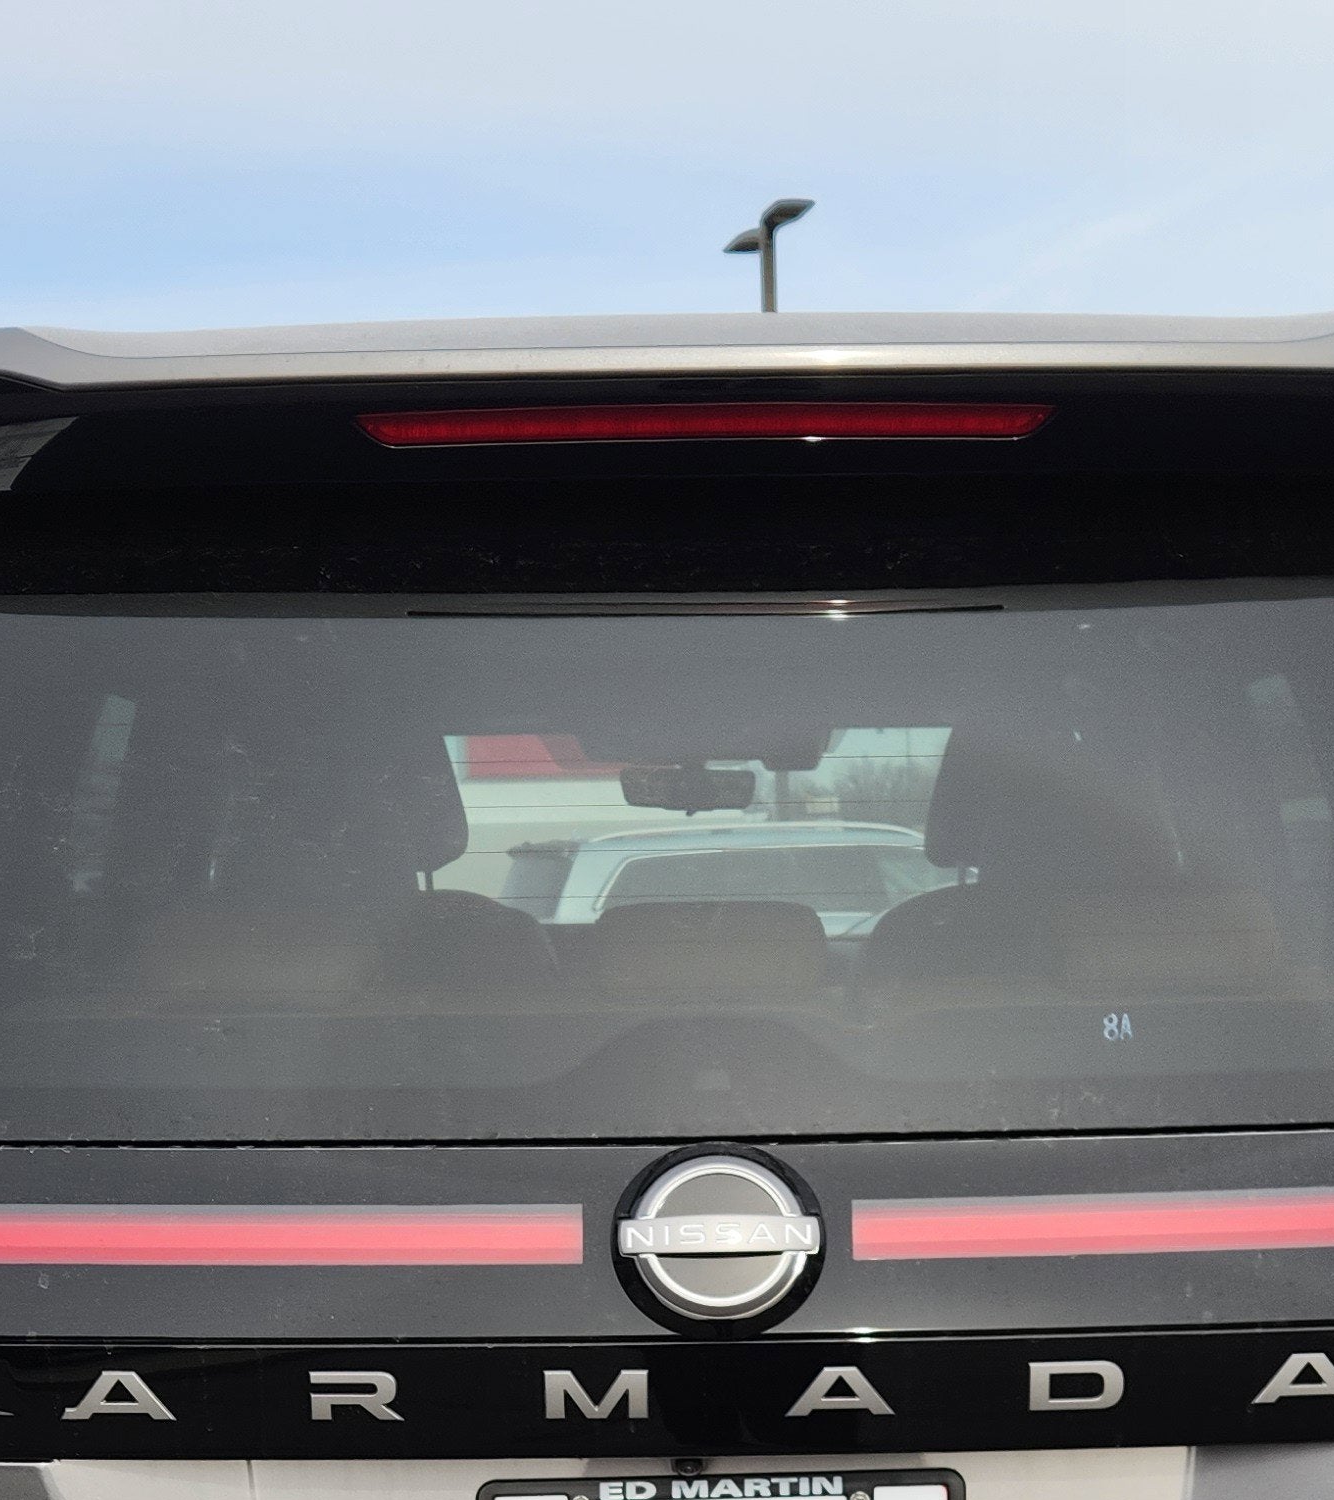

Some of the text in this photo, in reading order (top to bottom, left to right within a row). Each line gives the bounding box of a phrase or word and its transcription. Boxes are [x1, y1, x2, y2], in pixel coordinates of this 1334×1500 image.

[624, 1221, 813, 1253] NISSAN
[598, 1475, 844, 1500] ED MARTIN
